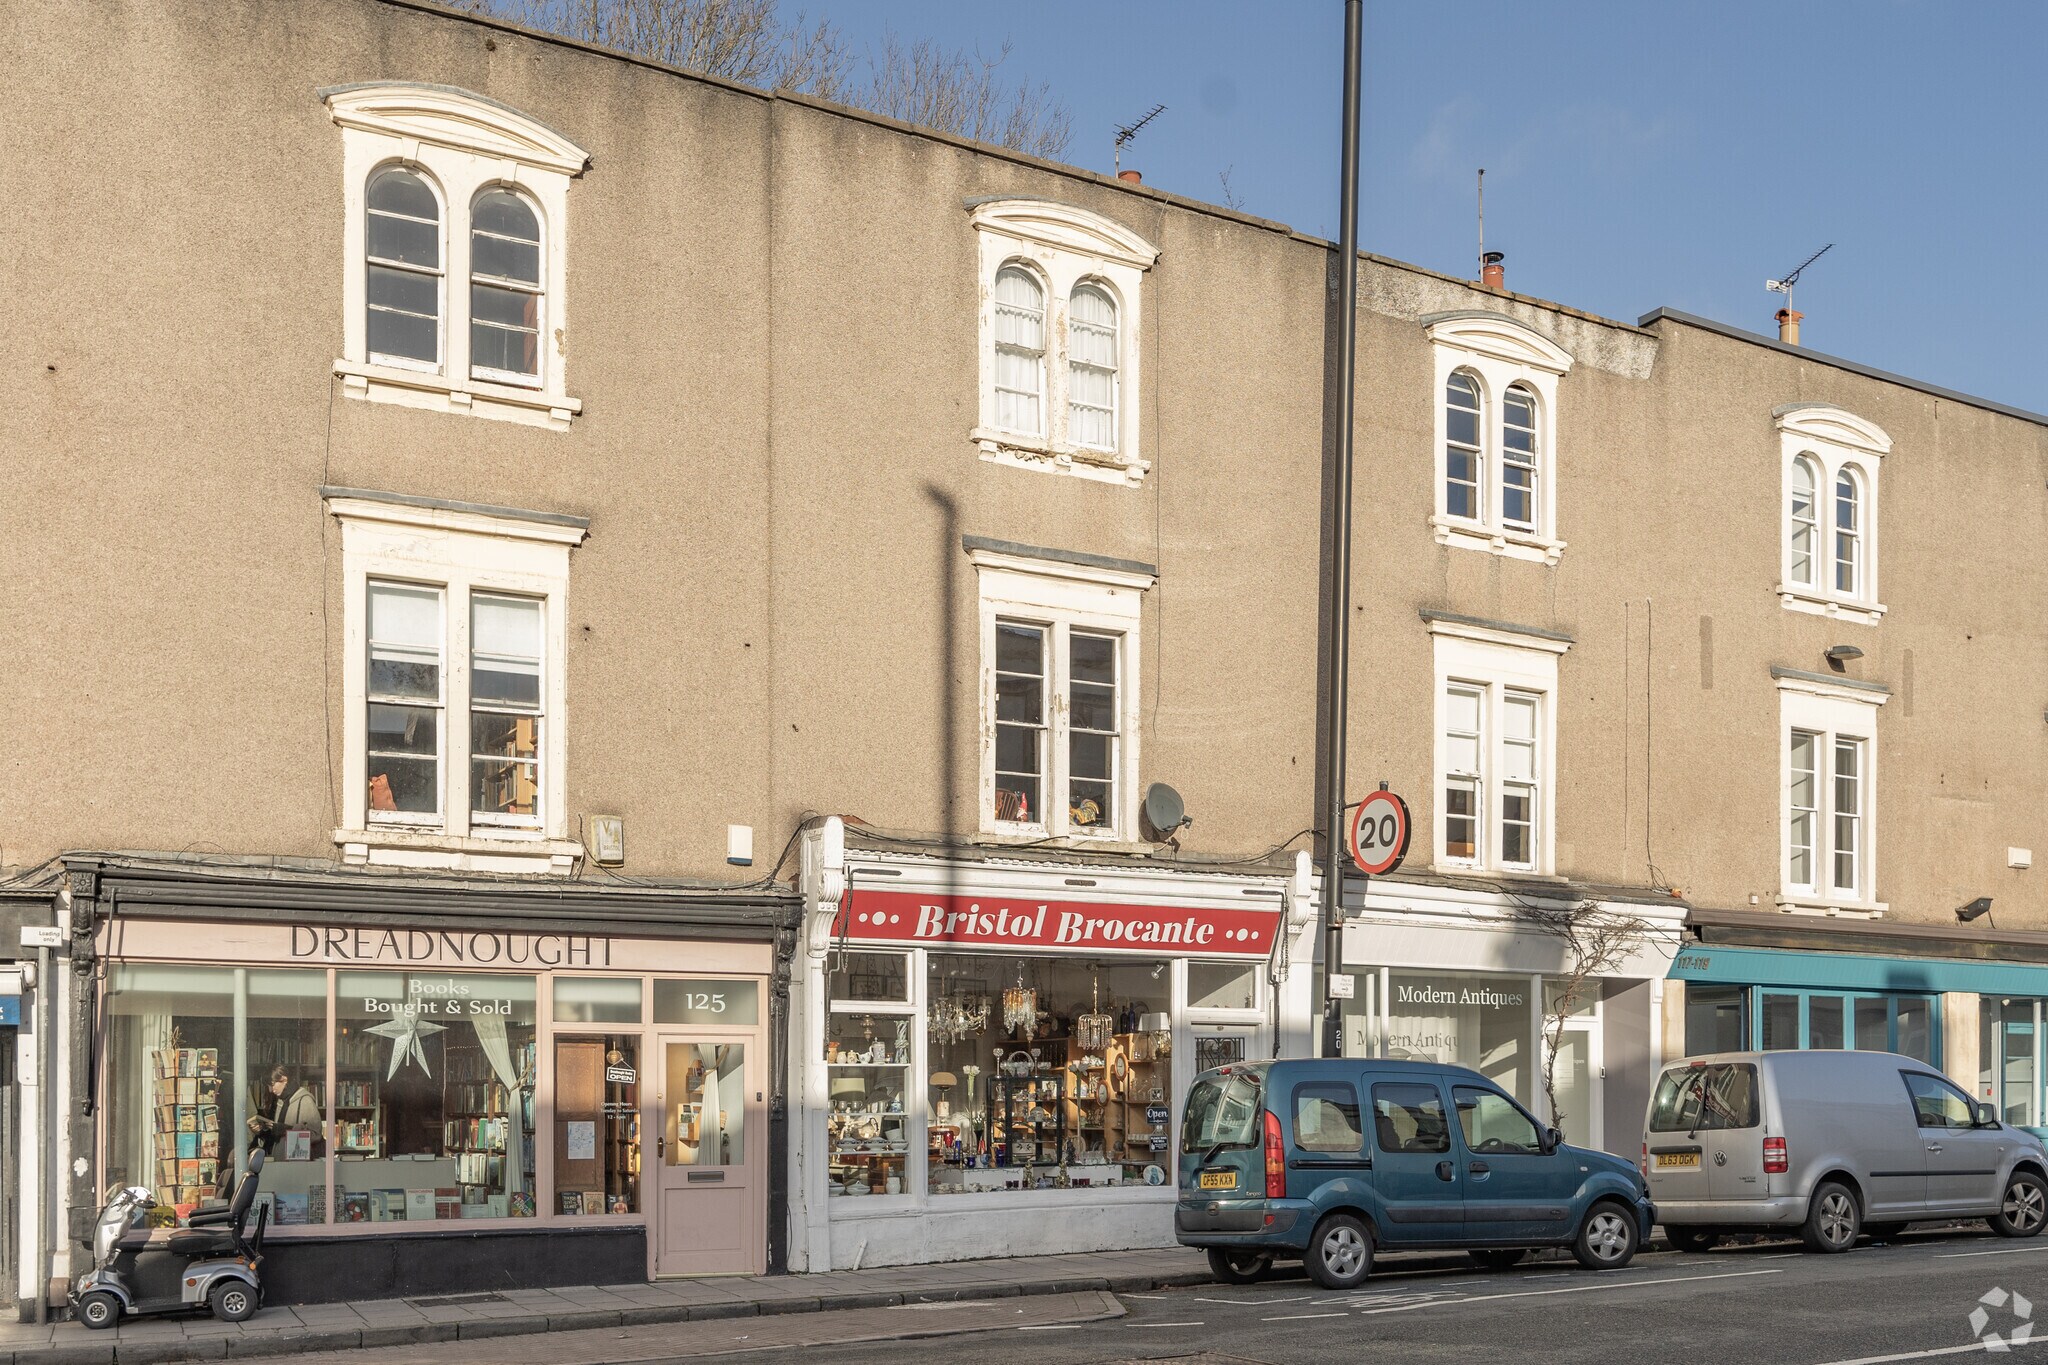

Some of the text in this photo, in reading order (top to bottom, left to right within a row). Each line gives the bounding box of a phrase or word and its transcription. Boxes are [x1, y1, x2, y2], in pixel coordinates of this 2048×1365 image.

[1360, 814, 1397, 850] 20
[913, 903, 1214, 945] Bristol Brocante
[291, 925, 618, 966] DREADNOUGHT
[409, 979, 470, 995] Books
[685, 993, 726, 1013] 125
[1398, 985, 1523, 1010] Modern Antiques
[364, 998, 512, 1018] Bought & Sold
[1147, 1108, 1168, 1120] Open
[1659, 1155, 1696, 1166] DL63 OGK
[1203, 1175, 1233, 1186] CF55 KXN
